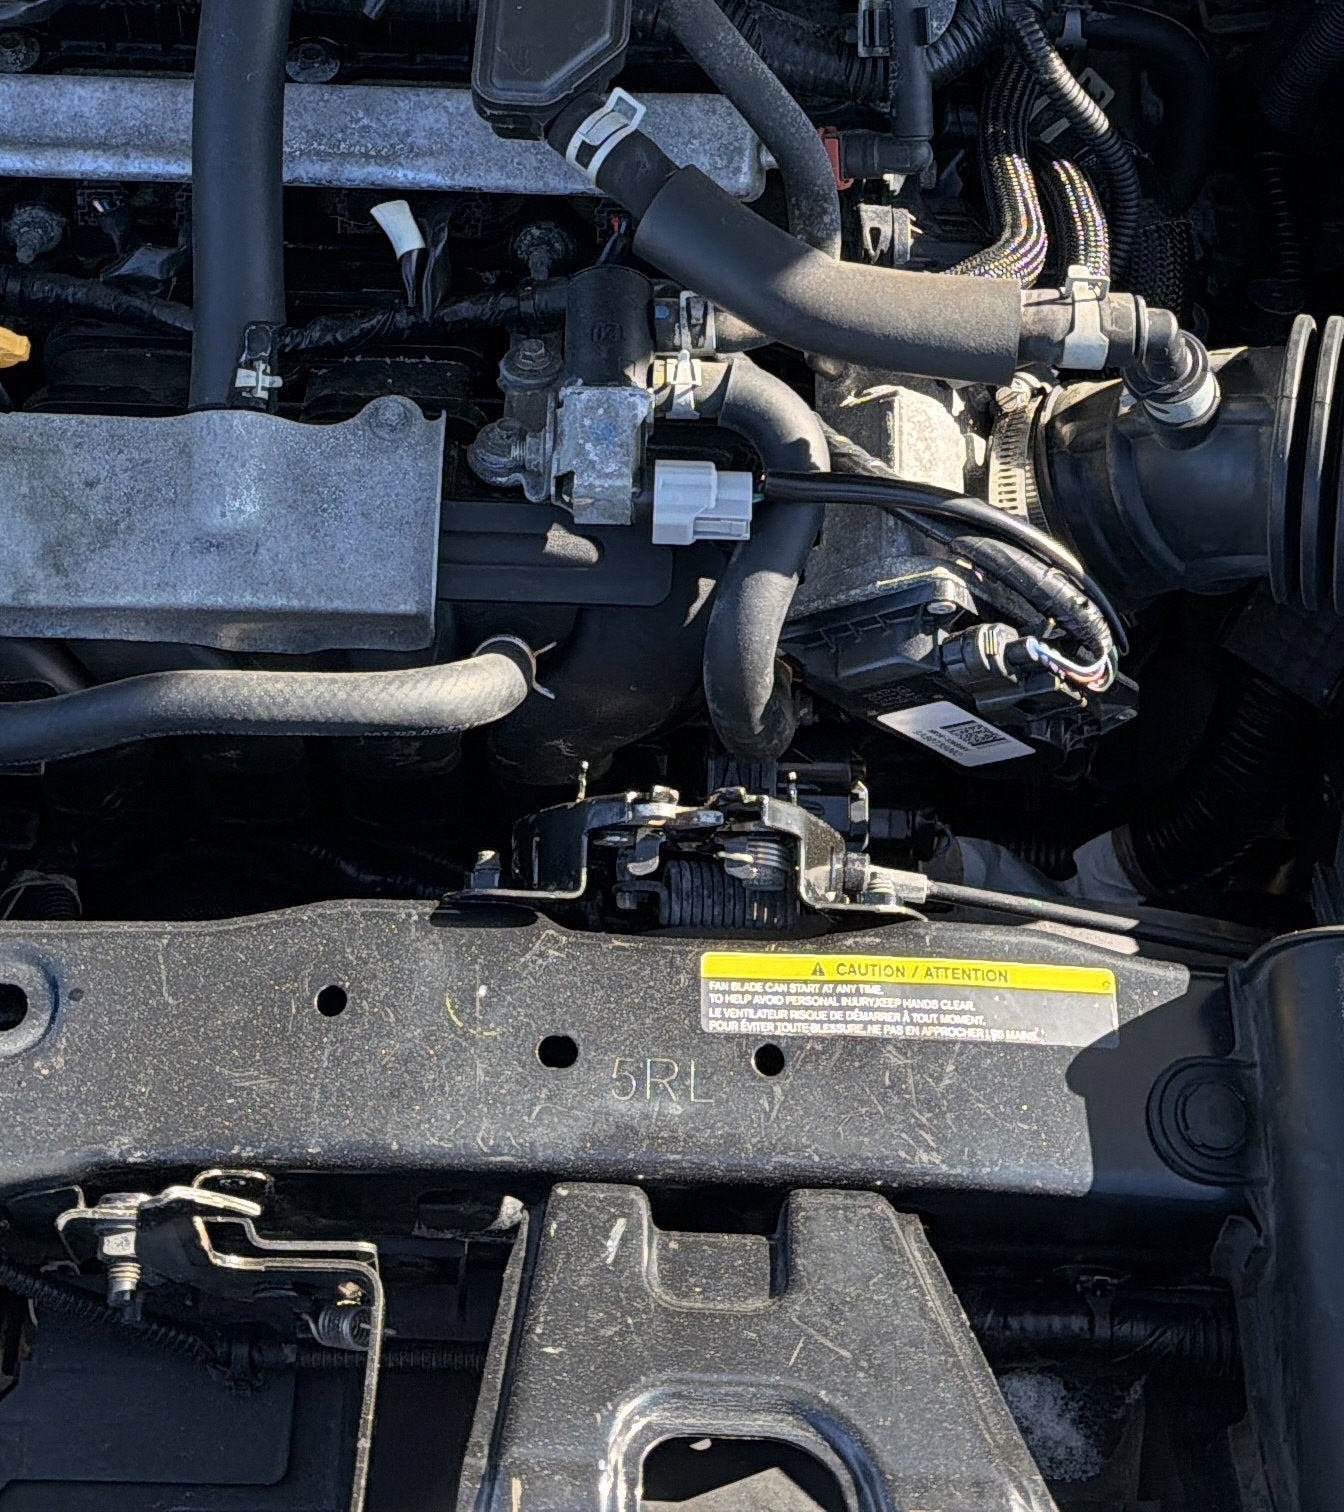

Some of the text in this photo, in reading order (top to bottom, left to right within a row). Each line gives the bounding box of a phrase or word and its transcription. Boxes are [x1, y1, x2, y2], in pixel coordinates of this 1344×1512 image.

[836, 963, 906, 979] CAUTION
[923, 966, 1009, 984] ATTENTION
[731, 981, 764, 992] BLADE
[766, 982, 788, 993] CAN
[789, 983, 821, 994] START
[821, 984, 835, 994] AT
[836, 984, 857, 994] ANY
[709, 993, 724, 1003] TO
[725, 994, 751, 1005] HELP
[752, 994, 784, 1005] AVOID
[786, 995, 840, 1007] PERSONAL
[902, 999, 939, 1009] HANDS
[709, 1008, 723, 1018] LE
[723, 1008, 788, 1020] VENTILATEUR
[790, 1010, 828, 1021] RISQUE
[830, 1011, 845, 1021] DE
[912, 1013, 938, 1024] TOUT
[709, 1020, 739, 1031] POUR
[867, 1023, 882, 1034] NE
[883, 1024, 903, 1035] PAS
[906, 1025, 920, 1036] EN
[921, 1026, 986, 1038] APPROCHER
[611, 1056, 716, 1104] 5RL
